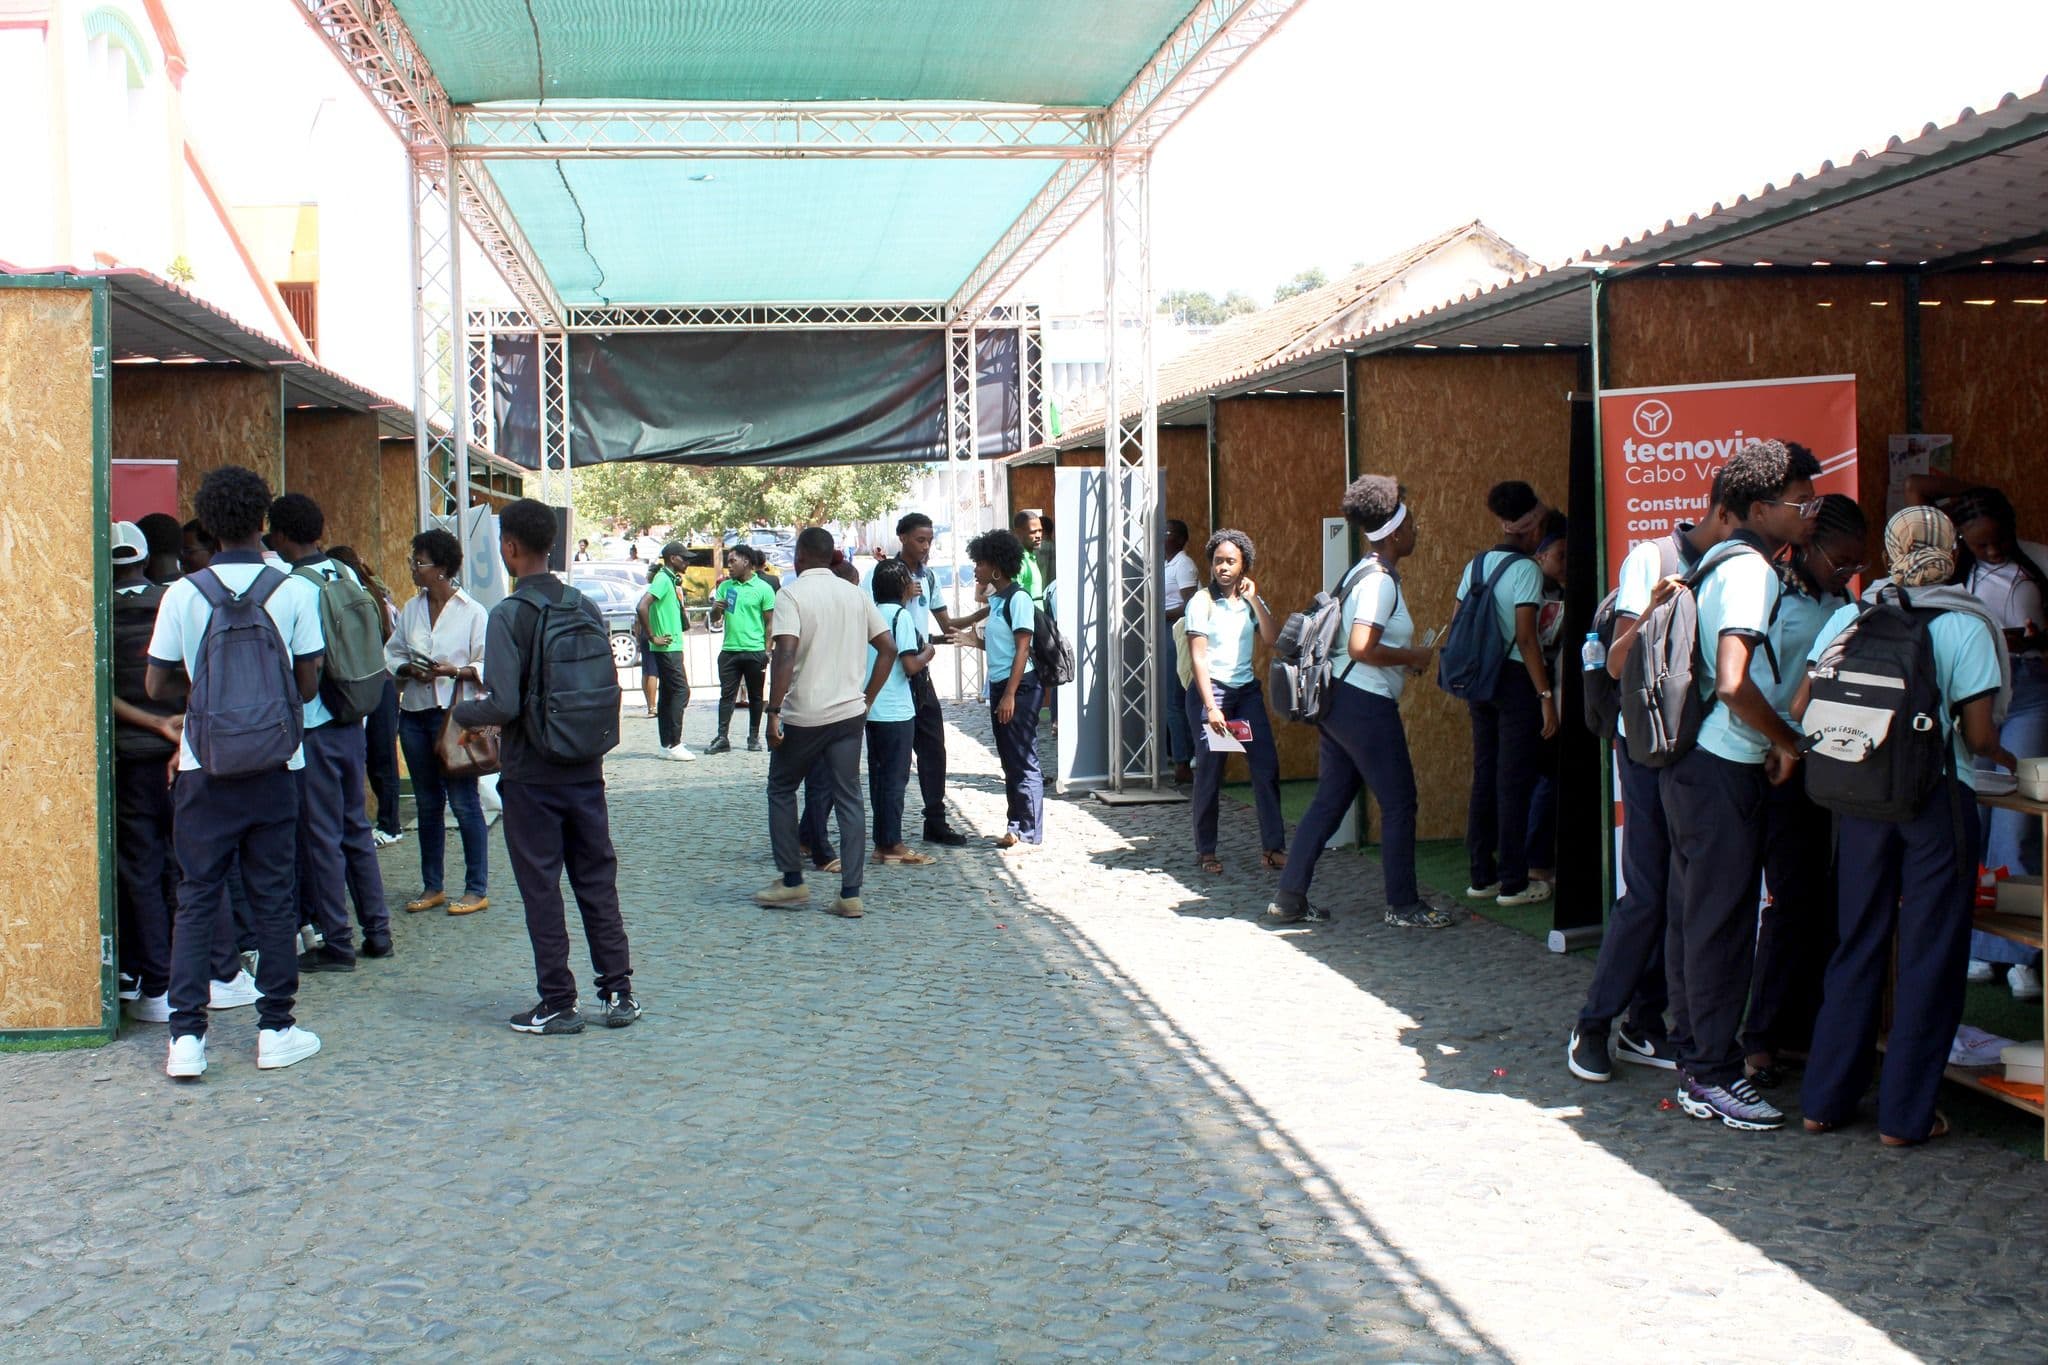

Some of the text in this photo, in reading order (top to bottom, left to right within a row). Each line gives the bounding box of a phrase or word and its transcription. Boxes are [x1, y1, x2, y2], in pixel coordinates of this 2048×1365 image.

[1625, 461, 1723, 484] Cabo Ve
[1626, 494, 1709, 512] Construí
[1627, 517, 1668, 531] com
